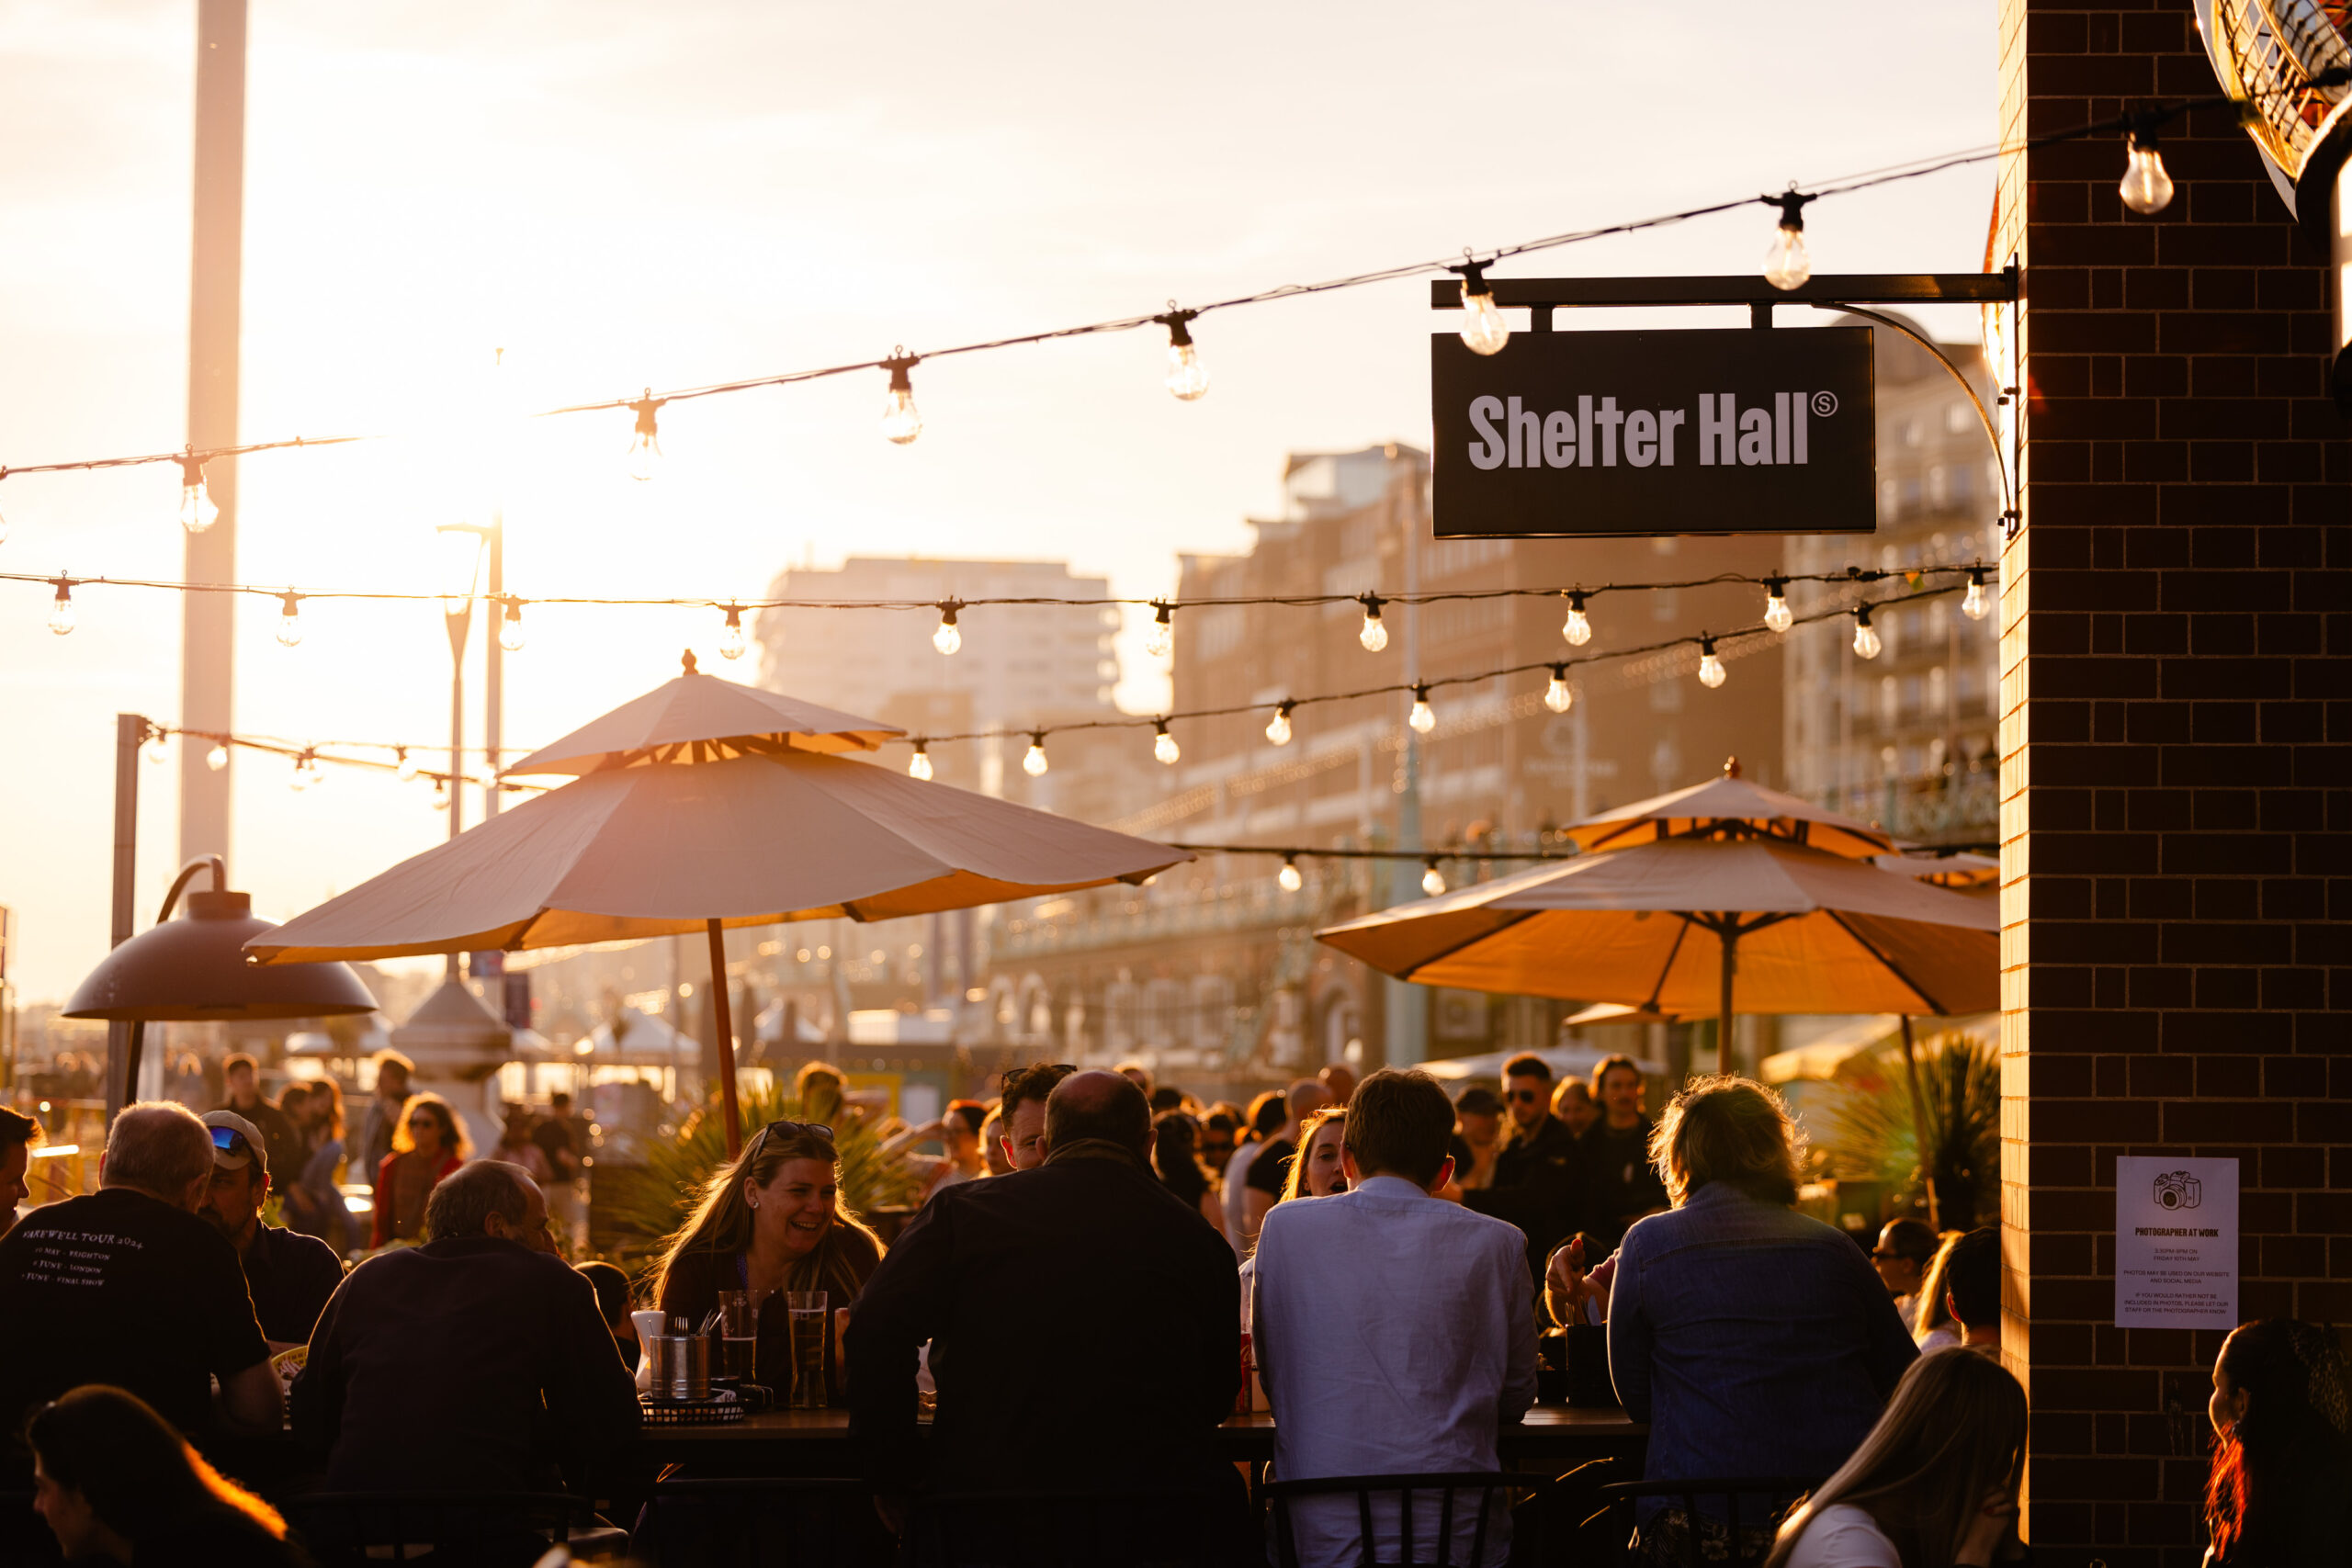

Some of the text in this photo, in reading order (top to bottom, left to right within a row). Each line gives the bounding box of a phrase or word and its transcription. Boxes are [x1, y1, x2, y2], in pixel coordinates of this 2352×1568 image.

[1468, 394, 1684, 470] Shelter
[1699, 392, 1808, 465] Hall
[2135, 1227, 2219, 1237] PHOTOGRAPHER AT WORK
[22, 1230, 144, 1250] FAREWELL TOUR 2024
[69, 1250, 110, 1260] BRIGHTON
[38, 1260, 62, 1270] JUNE
[70, 1264, 102, 1274] LONDON
[26, 1272, 50, 1282] JUNE
[56, 1276, 79, 1285] FINAL
[81, 1278, 105, 1287] SHOW
